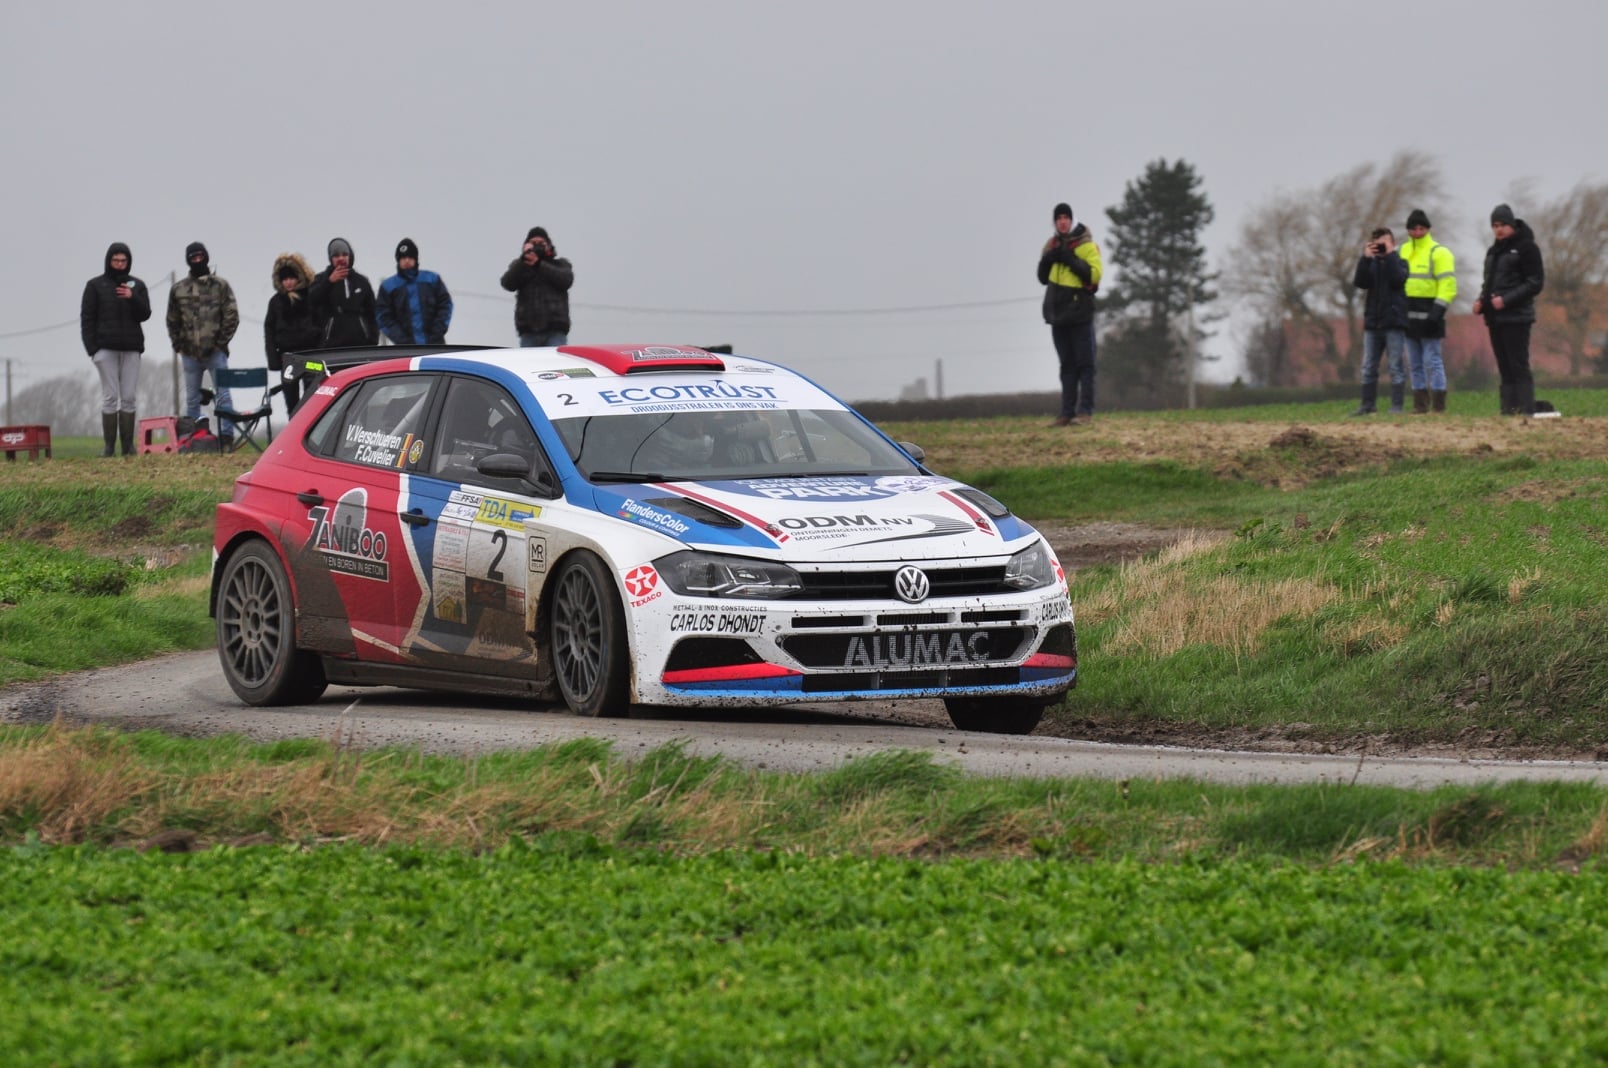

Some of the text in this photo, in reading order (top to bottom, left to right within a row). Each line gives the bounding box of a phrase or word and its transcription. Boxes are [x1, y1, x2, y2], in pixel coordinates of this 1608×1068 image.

[557, 393, 579, 407] 2
[598, 381, 777, 404] ECOTRUST
[346, 424, 402, 449] V.Verschueren
[354, 445, 395, 466] F.Cuvelier
[756, 485, 889, 499] PARK
[481, 499, 508, 521] TDA
[620, 498, 690, 533] FlandersColor
[779, 514, 914, 530] ODM NV
[790, 526, 858, 537] ONTGINNINGEN
[794, 533, 847, 542] MOORSLEDE
[487, 529, 508, 582] 2
[531, 543, 543, 559] MR
[364, 563, 385, 576] BETON
[629, 590, 662, 609] TEXACO
[720, 605, 768, 613] CONSTRUCTIES
[670, 613, 767, 634] CARLOS DHONDT
[843, 631, 991, 668] ALUMAC
